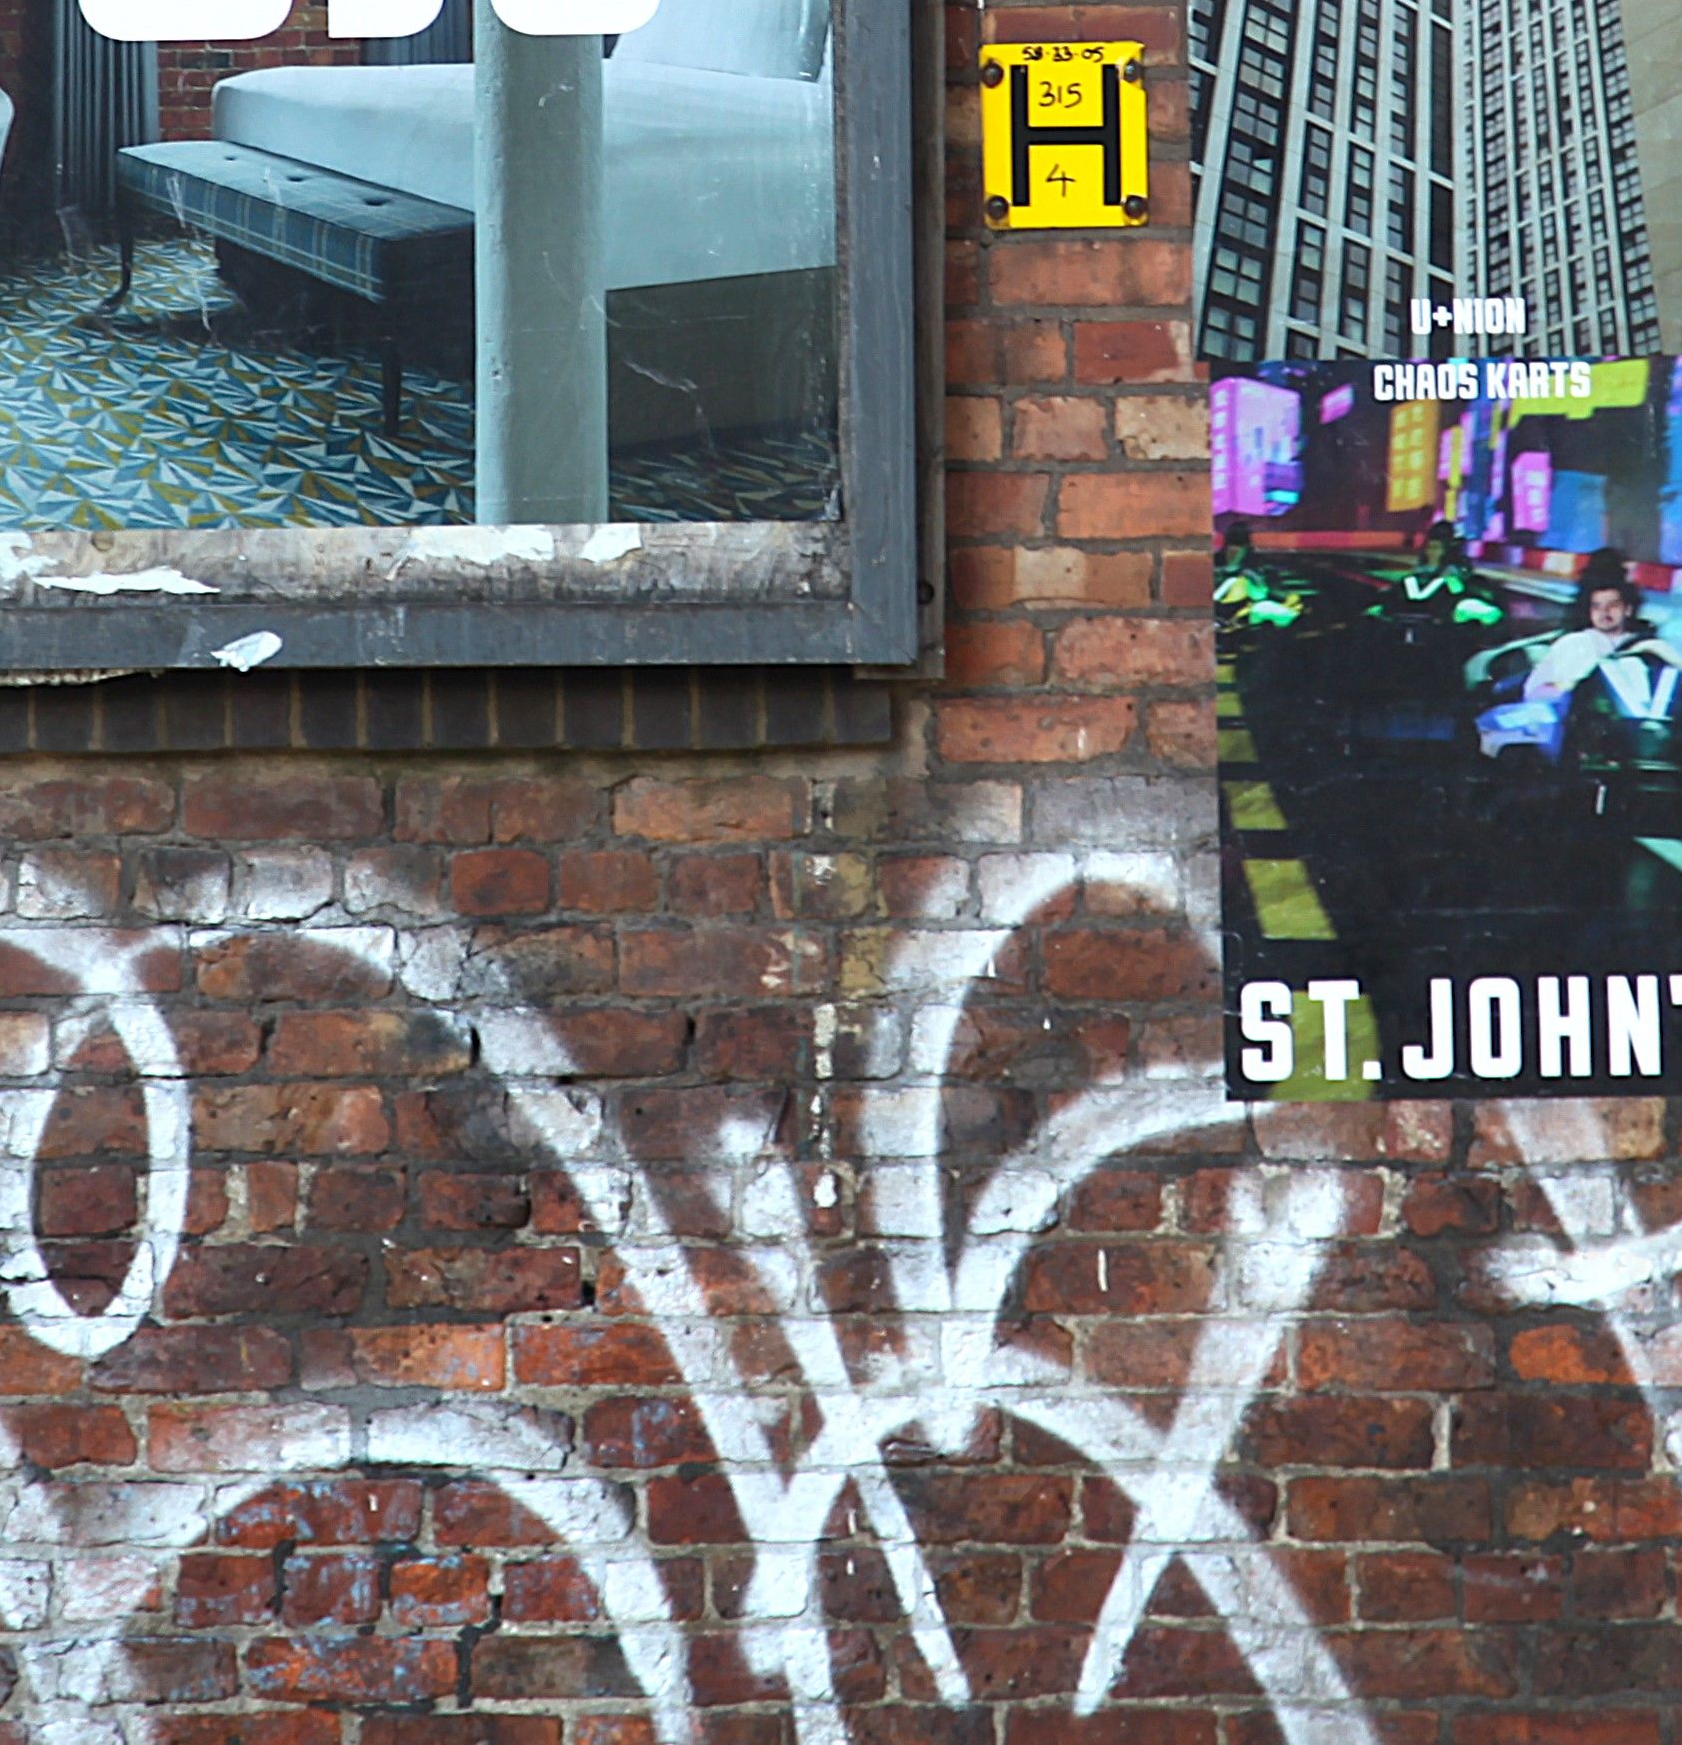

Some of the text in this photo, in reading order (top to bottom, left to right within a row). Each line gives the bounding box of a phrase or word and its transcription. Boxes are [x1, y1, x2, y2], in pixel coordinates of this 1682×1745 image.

[1038, 81, 1083, 108] 315
[1011, 64, 1122, 207] H
[1045, 163, 1076, 198] 4
[1410, 297, 1527, 335] U+NION
[1374, 360, 1592, 401] CHAOS KARTS
